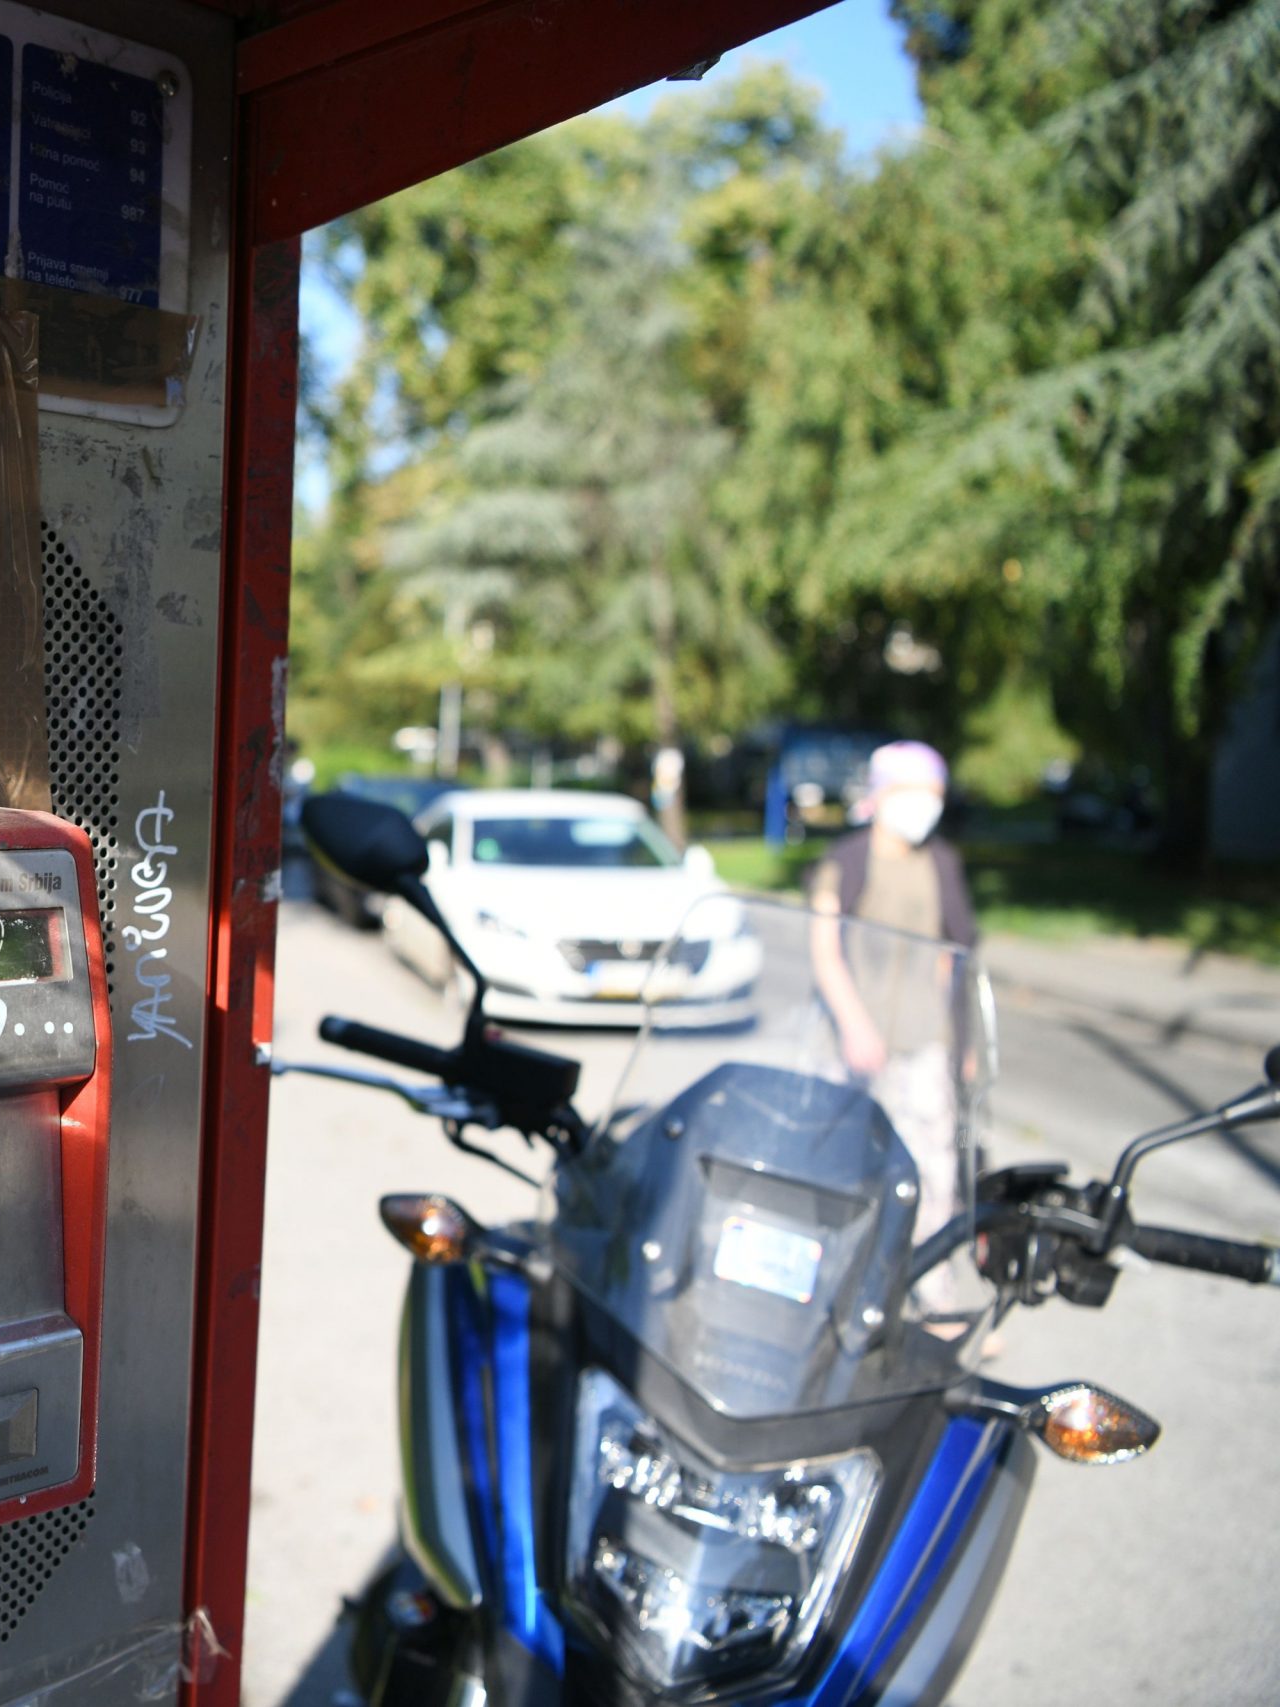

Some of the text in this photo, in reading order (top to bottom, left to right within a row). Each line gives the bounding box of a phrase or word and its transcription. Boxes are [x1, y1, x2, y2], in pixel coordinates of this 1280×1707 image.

[130, 110, 147, 128] 92
[130, 138, 146, 155] 93
[29, 172, 71, 195] Pomoć
[129, 168, 146, 185] 94
[29, 191, 72, 211] na putu
[120, 204, 145, 223] 987
[27, 251, 68, 272] Prijava
[26, 269, 42, 282] na
[19, 872, 62, 894] Srbija
